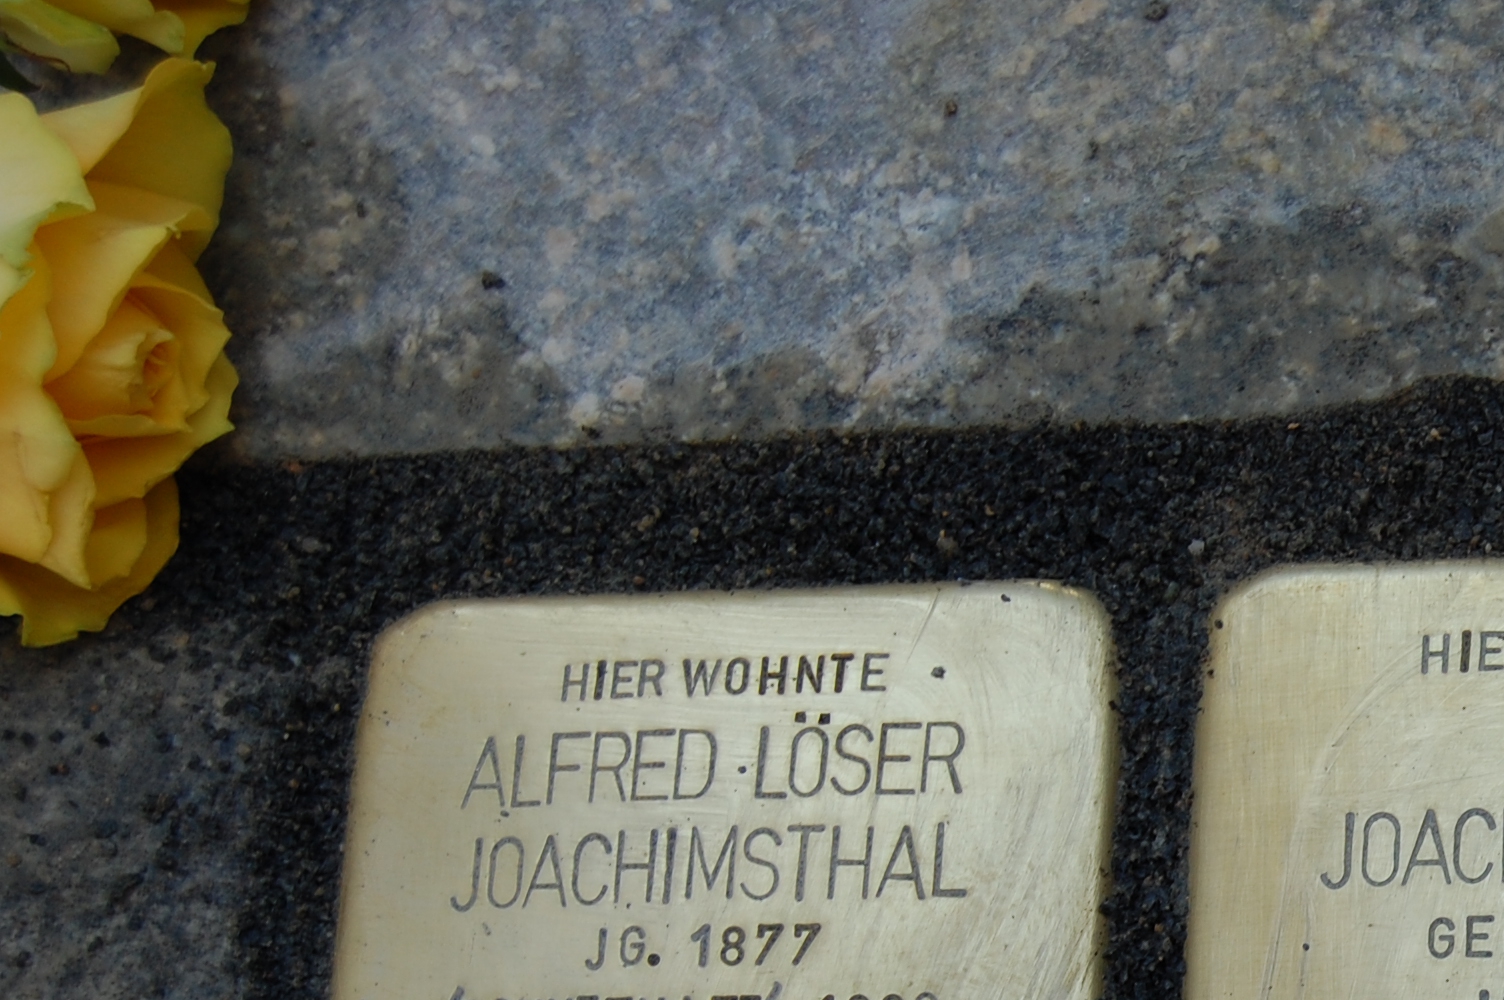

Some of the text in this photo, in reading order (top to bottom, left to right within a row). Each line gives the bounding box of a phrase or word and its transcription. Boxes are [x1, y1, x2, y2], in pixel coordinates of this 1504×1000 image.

[561, 653, 890, 703] HIER WOHNTE
[461, 711, 967, 810] ALFRED LÖSER
[450, 821, 968, 913] JOACHIMSTHAL
[585, 923, 823, 971] JG. 1877
